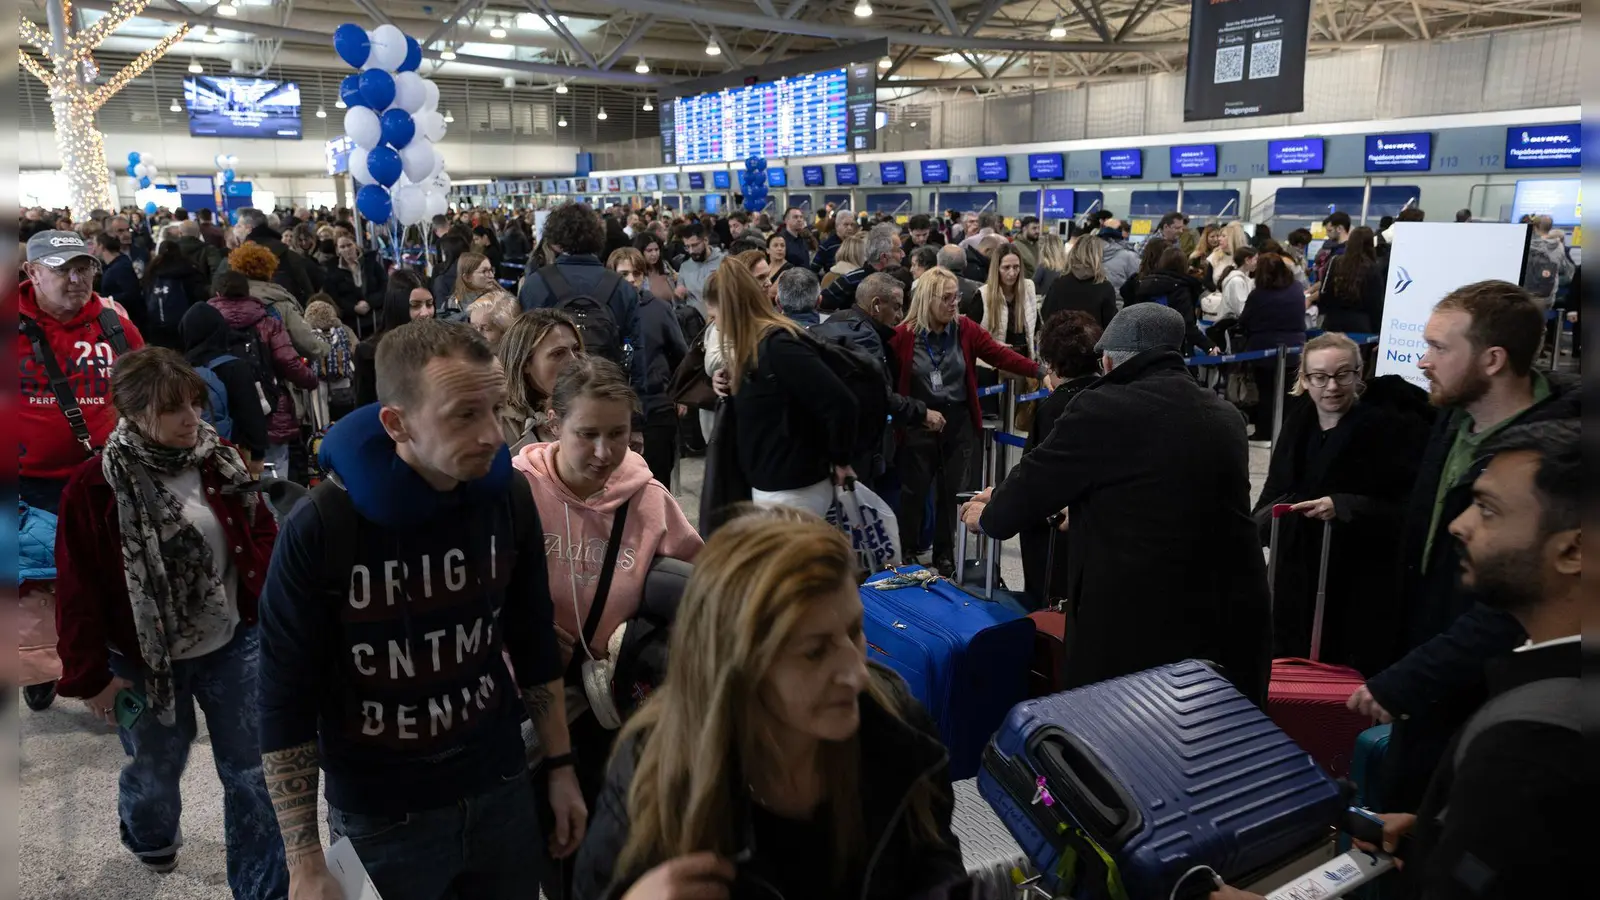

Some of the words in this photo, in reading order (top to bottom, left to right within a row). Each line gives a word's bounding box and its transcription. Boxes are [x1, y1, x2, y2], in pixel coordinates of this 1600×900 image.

[1440, 157, 1458, 168] 113
[1479, 155, 1499, 166] 112
[180, 180, 188, 190] B
[229, 185, 238, 194] C
[1390, 318, 1427, 333] Read
[1387, 350, 1411, 363] Not
[1416, 353, 1426, 363] Y
[30, 396, 105, 404] PERFANCE
[542, 532, 636, 570] Adids
